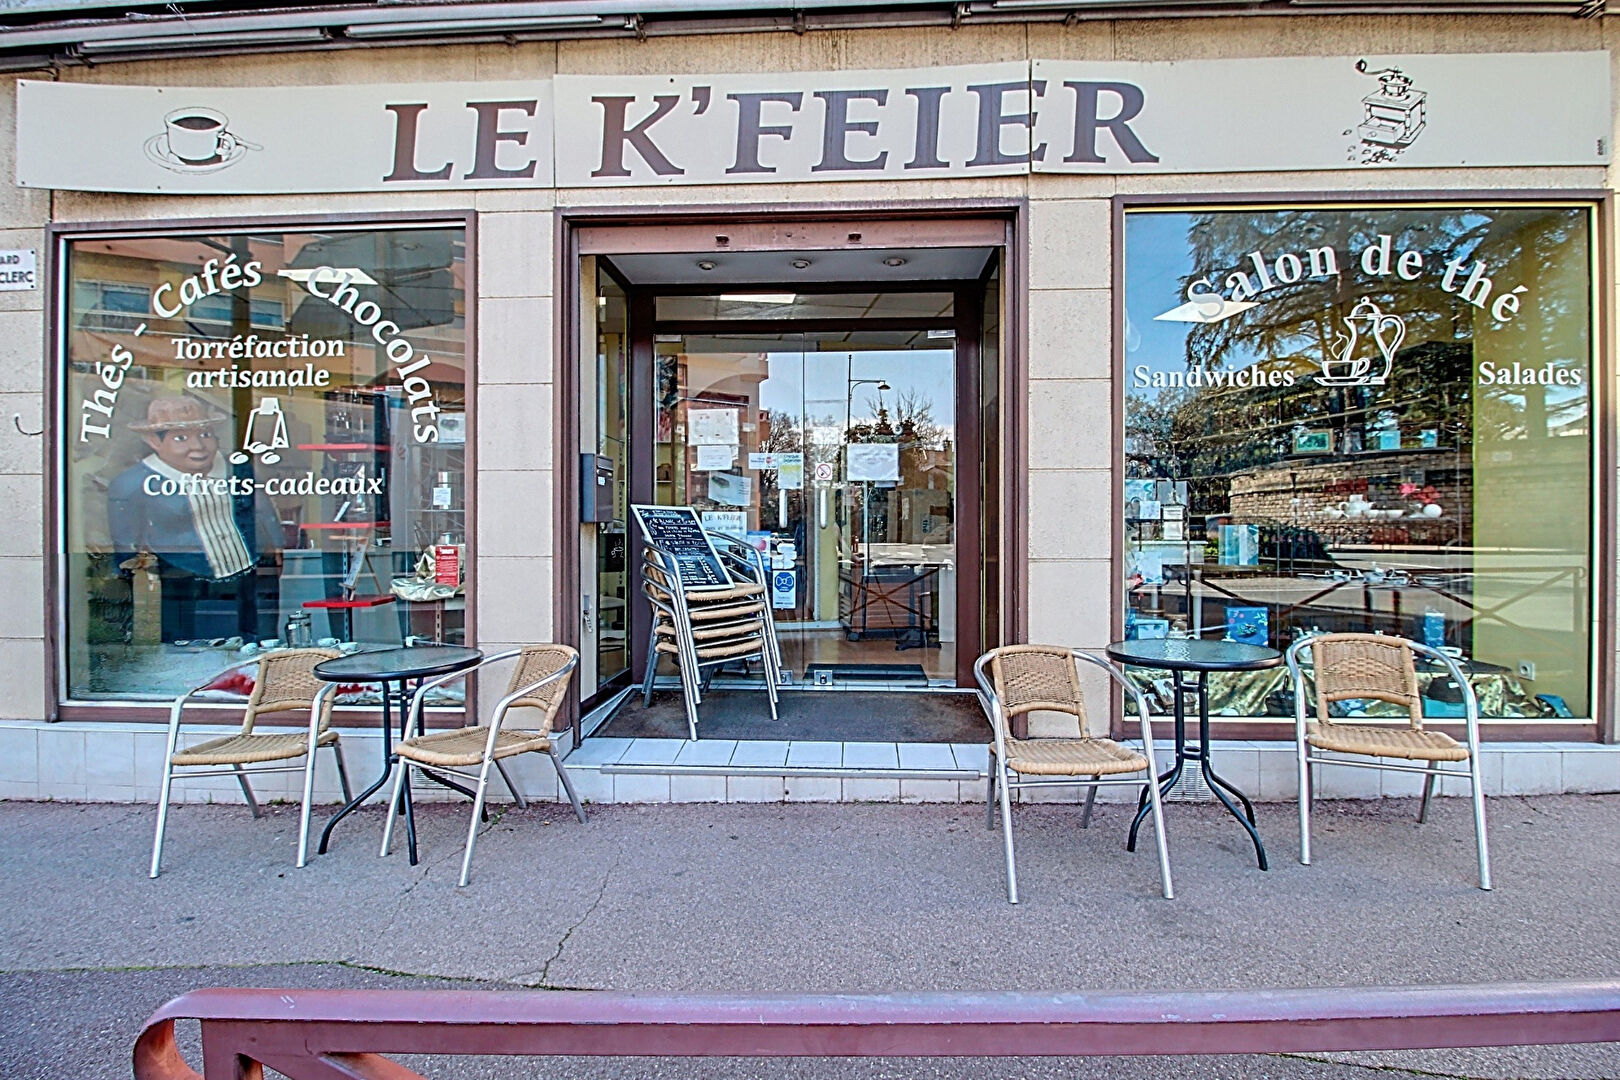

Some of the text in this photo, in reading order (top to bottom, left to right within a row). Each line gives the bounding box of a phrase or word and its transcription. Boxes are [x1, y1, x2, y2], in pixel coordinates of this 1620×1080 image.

[383, 99, 538, 182] LE
[1187, 234, 1529, 322] Salon de thé
[80, 343, 134, 444] Thés
[152, 253, 262, 320] Cafés
[306, 265, 441, 444] Chocolats
[171, 334, 345, 360] Torréfaction
[186, 363, 330, 388] artisanale
[1133, 364, 1295, 389] Sandwiches
[1478, 361, 1582, 386] Salades
[143, 472, 384, 497] Coffrets-cadeaux
